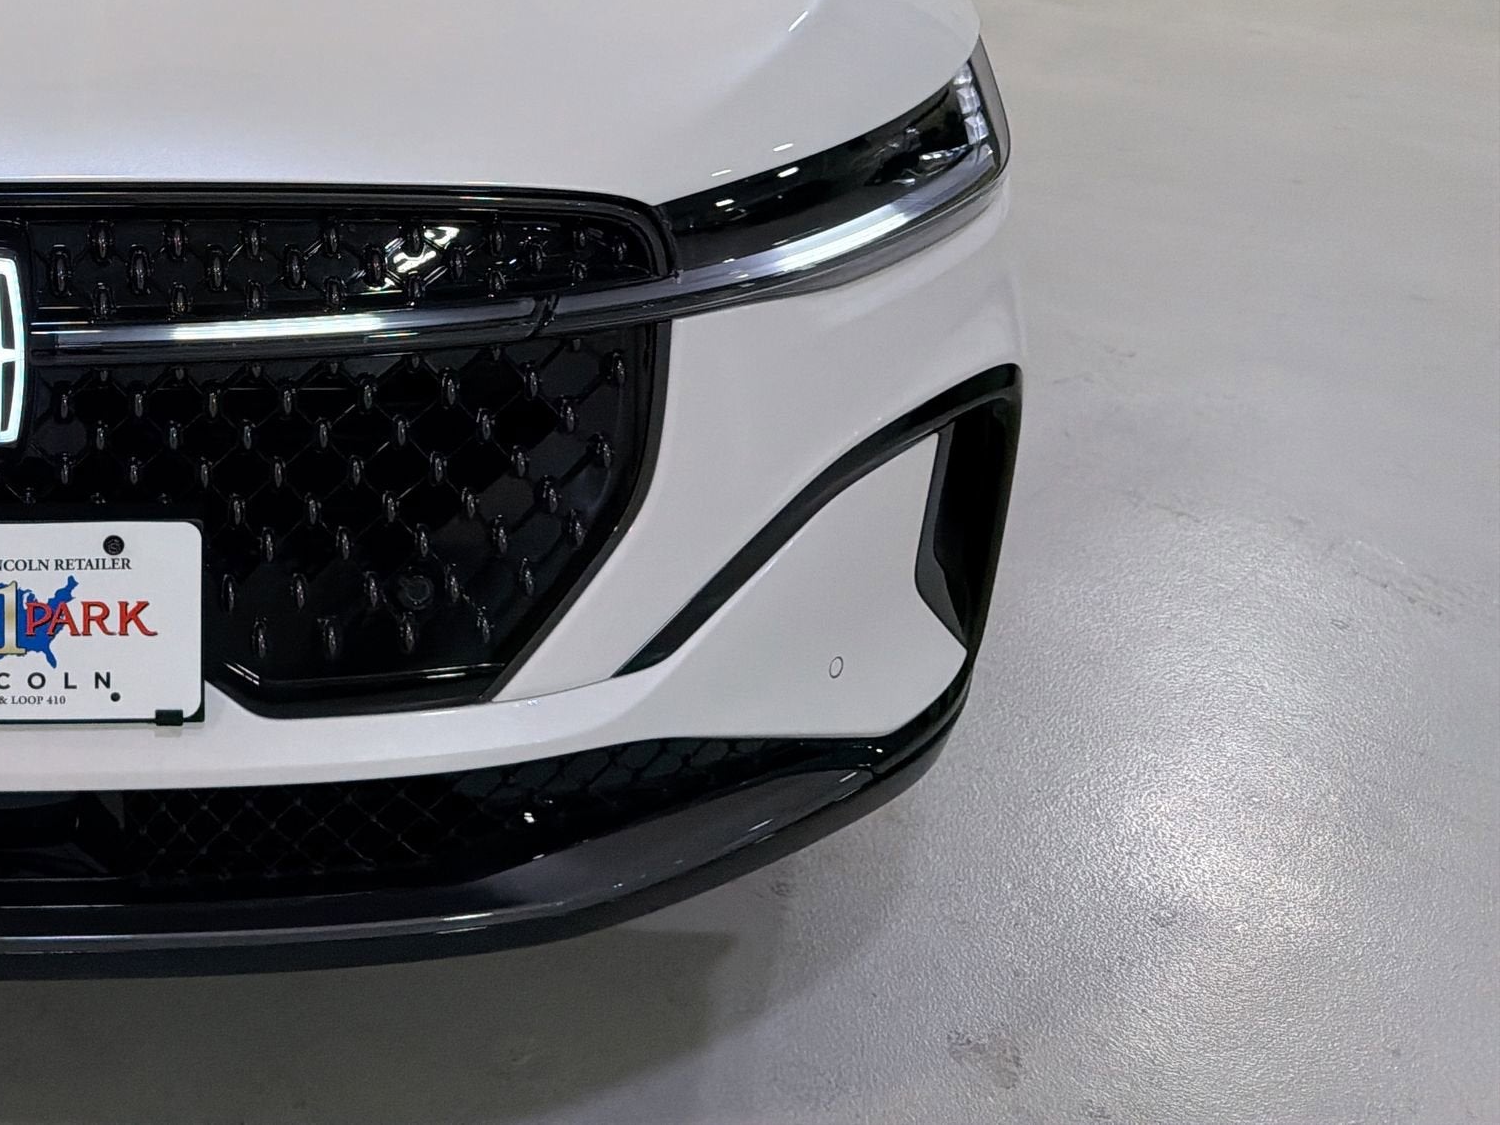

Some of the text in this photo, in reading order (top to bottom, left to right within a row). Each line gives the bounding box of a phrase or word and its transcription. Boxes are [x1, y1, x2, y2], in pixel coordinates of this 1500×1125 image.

[54, 557, 132, 571] RETAILER
[25, 600, 159, 637] PARK
[11, 695, 44, 705] LOOP
[46, 695, 67, 705] 410
